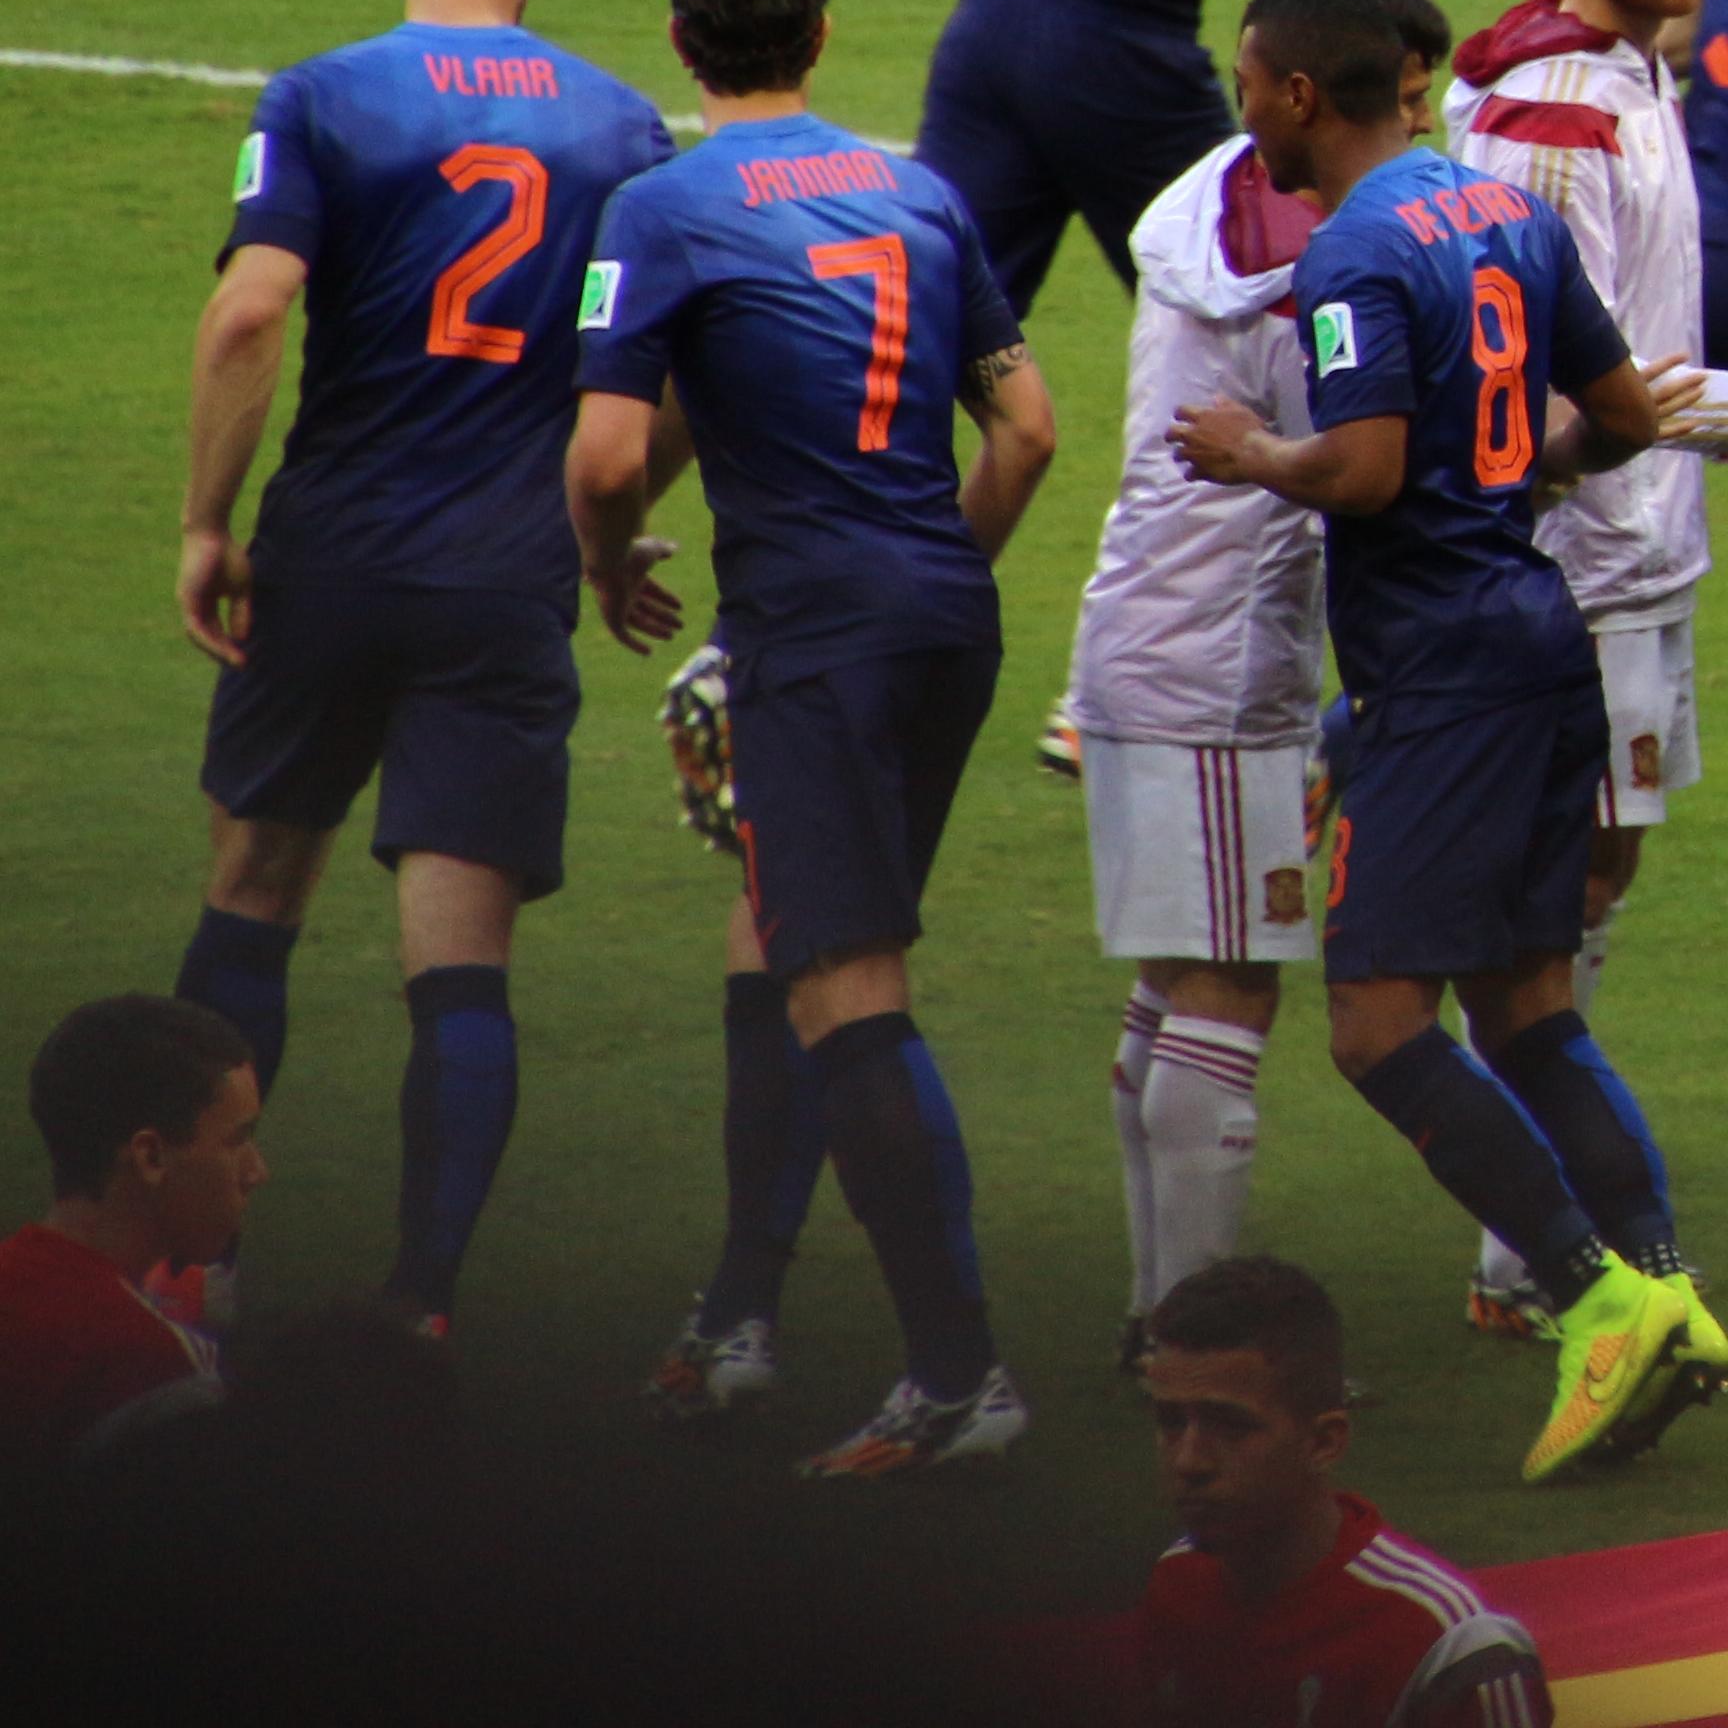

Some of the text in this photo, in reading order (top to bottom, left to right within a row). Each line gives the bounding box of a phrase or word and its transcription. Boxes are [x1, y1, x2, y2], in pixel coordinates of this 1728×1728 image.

[422, 52, 560, 99] VLAAR
[424, 143, 551, 366] 2
[807, 233, 910, 454] 7
[1469, 265, 1537, 489] 8
